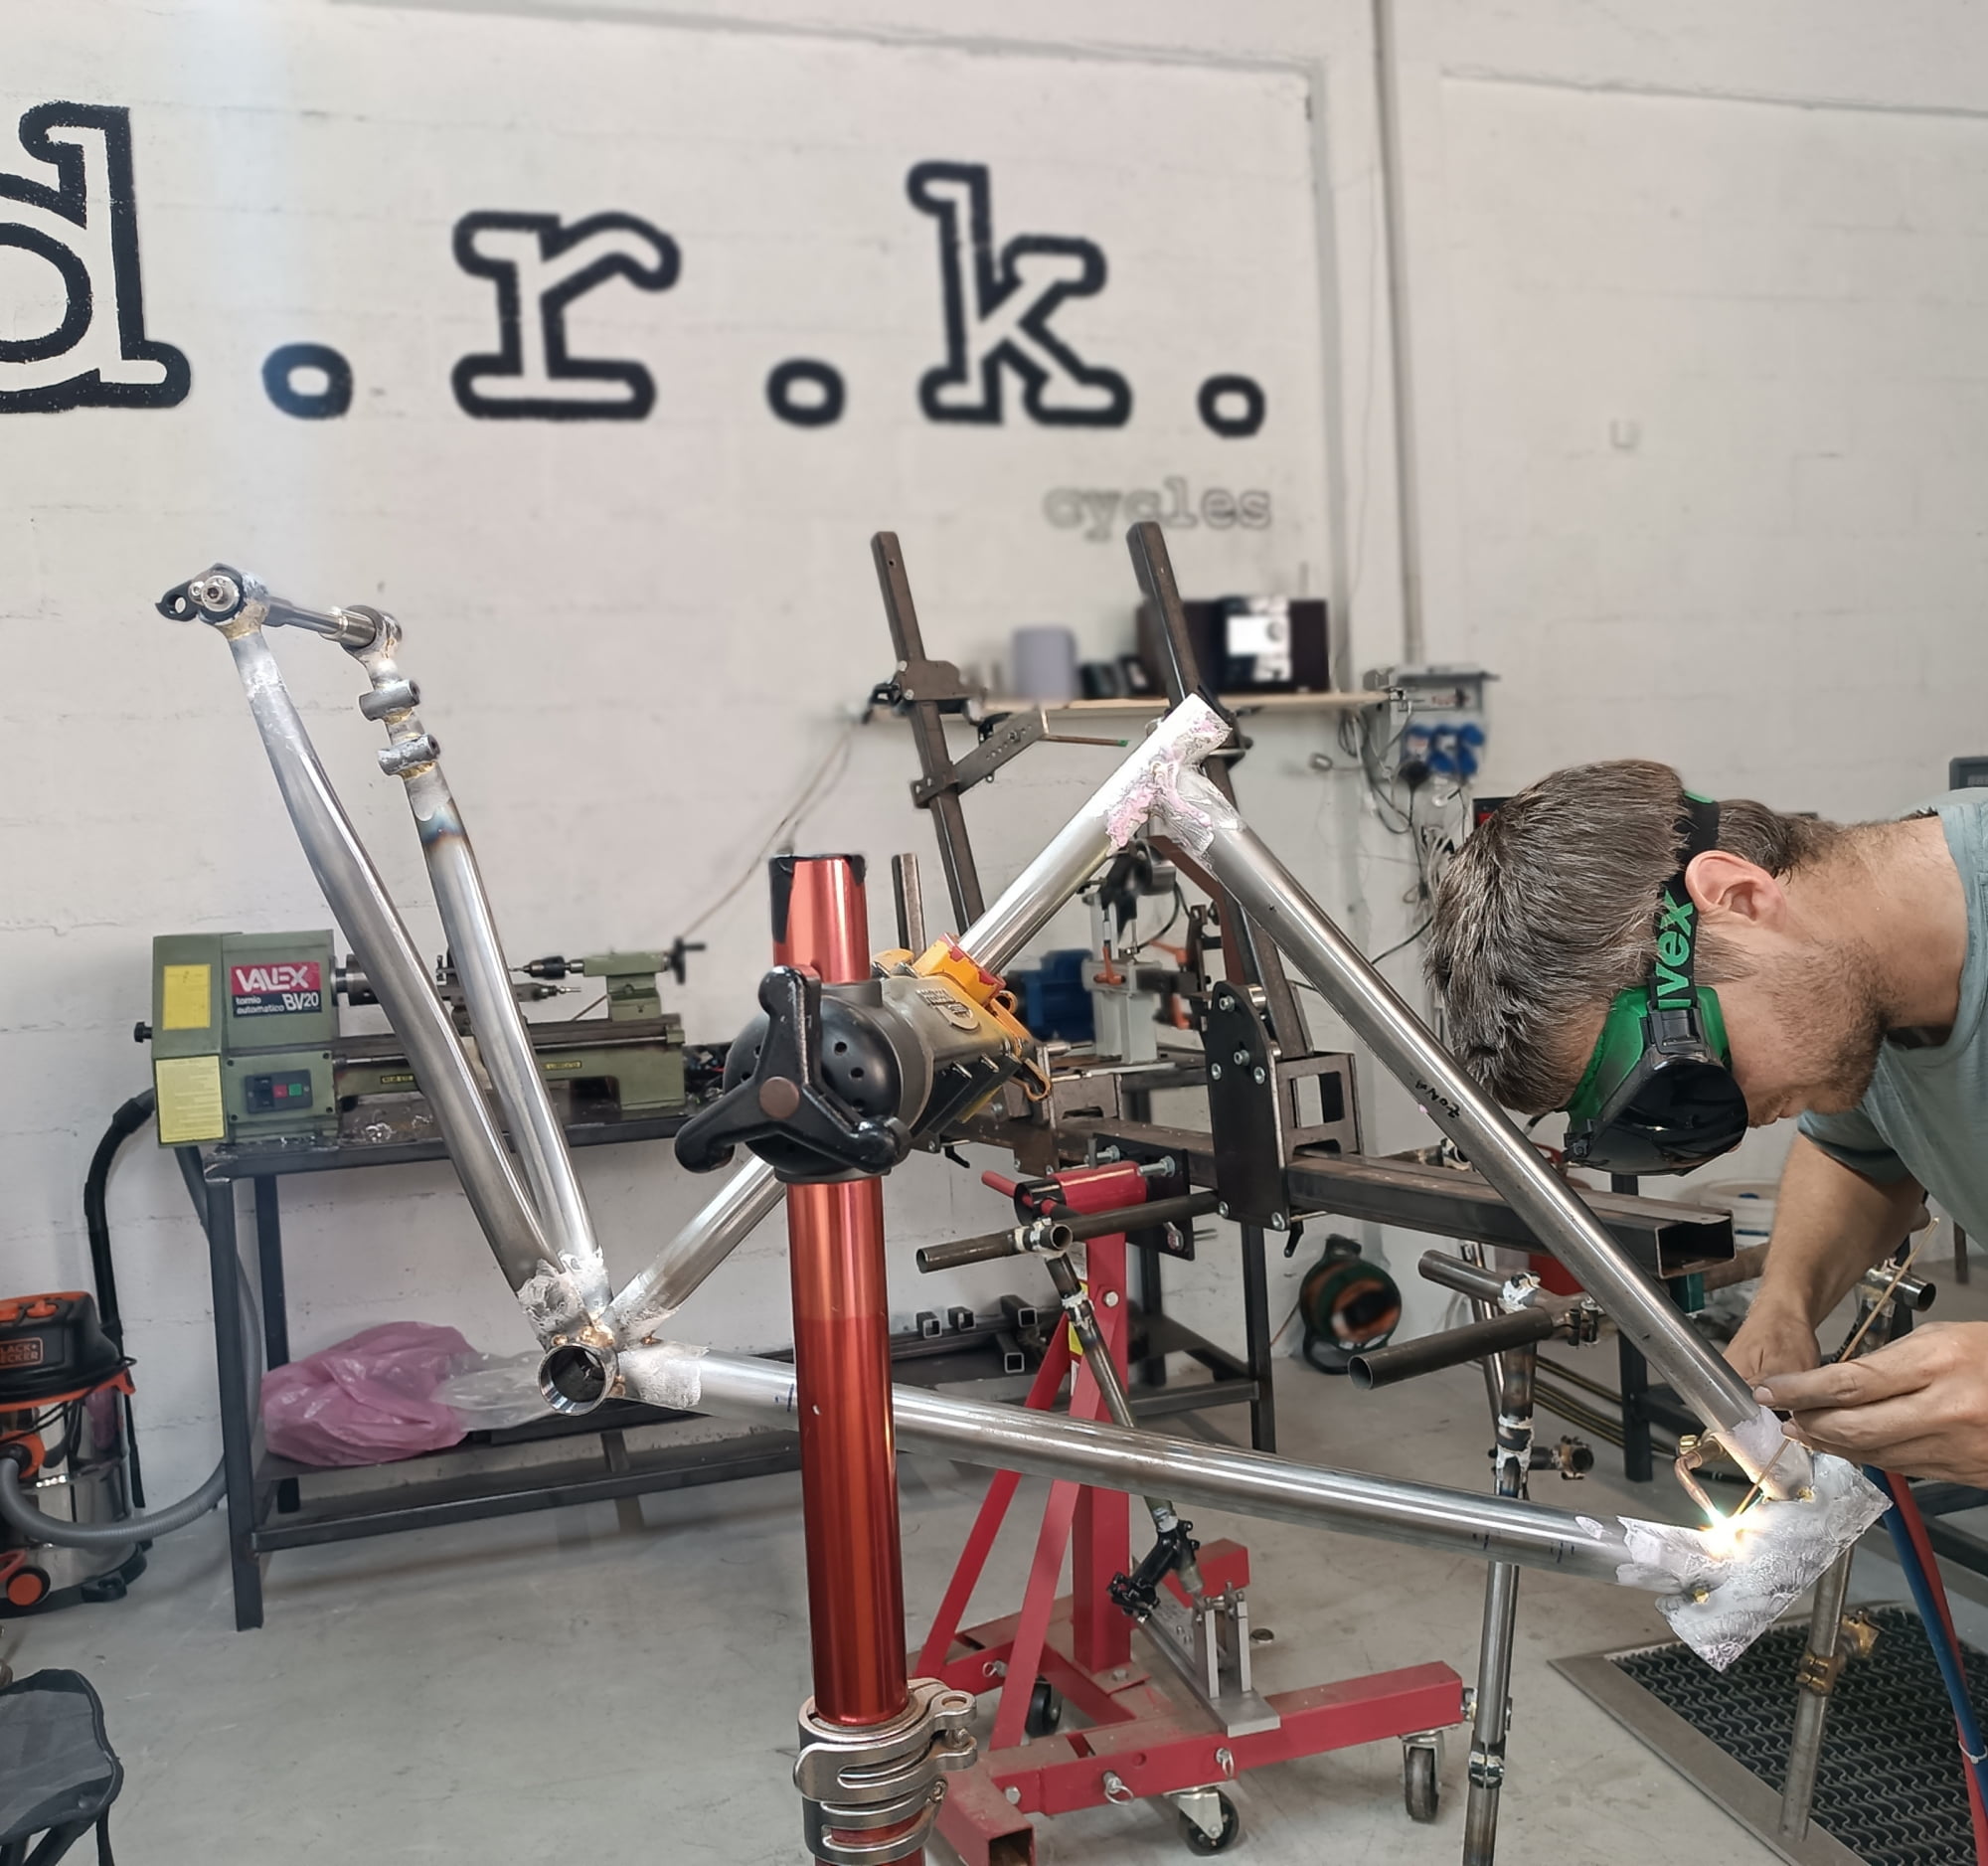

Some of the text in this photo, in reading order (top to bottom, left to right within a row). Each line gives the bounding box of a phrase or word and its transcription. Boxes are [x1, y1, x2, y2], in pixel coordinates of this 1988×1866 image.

[1043, 475, 1272, 543] cycles
[236, 965, 309, 992] VALEX
[237, 1004, 284, 1014] automatico
[282, 992, 319, 1010] BV20
